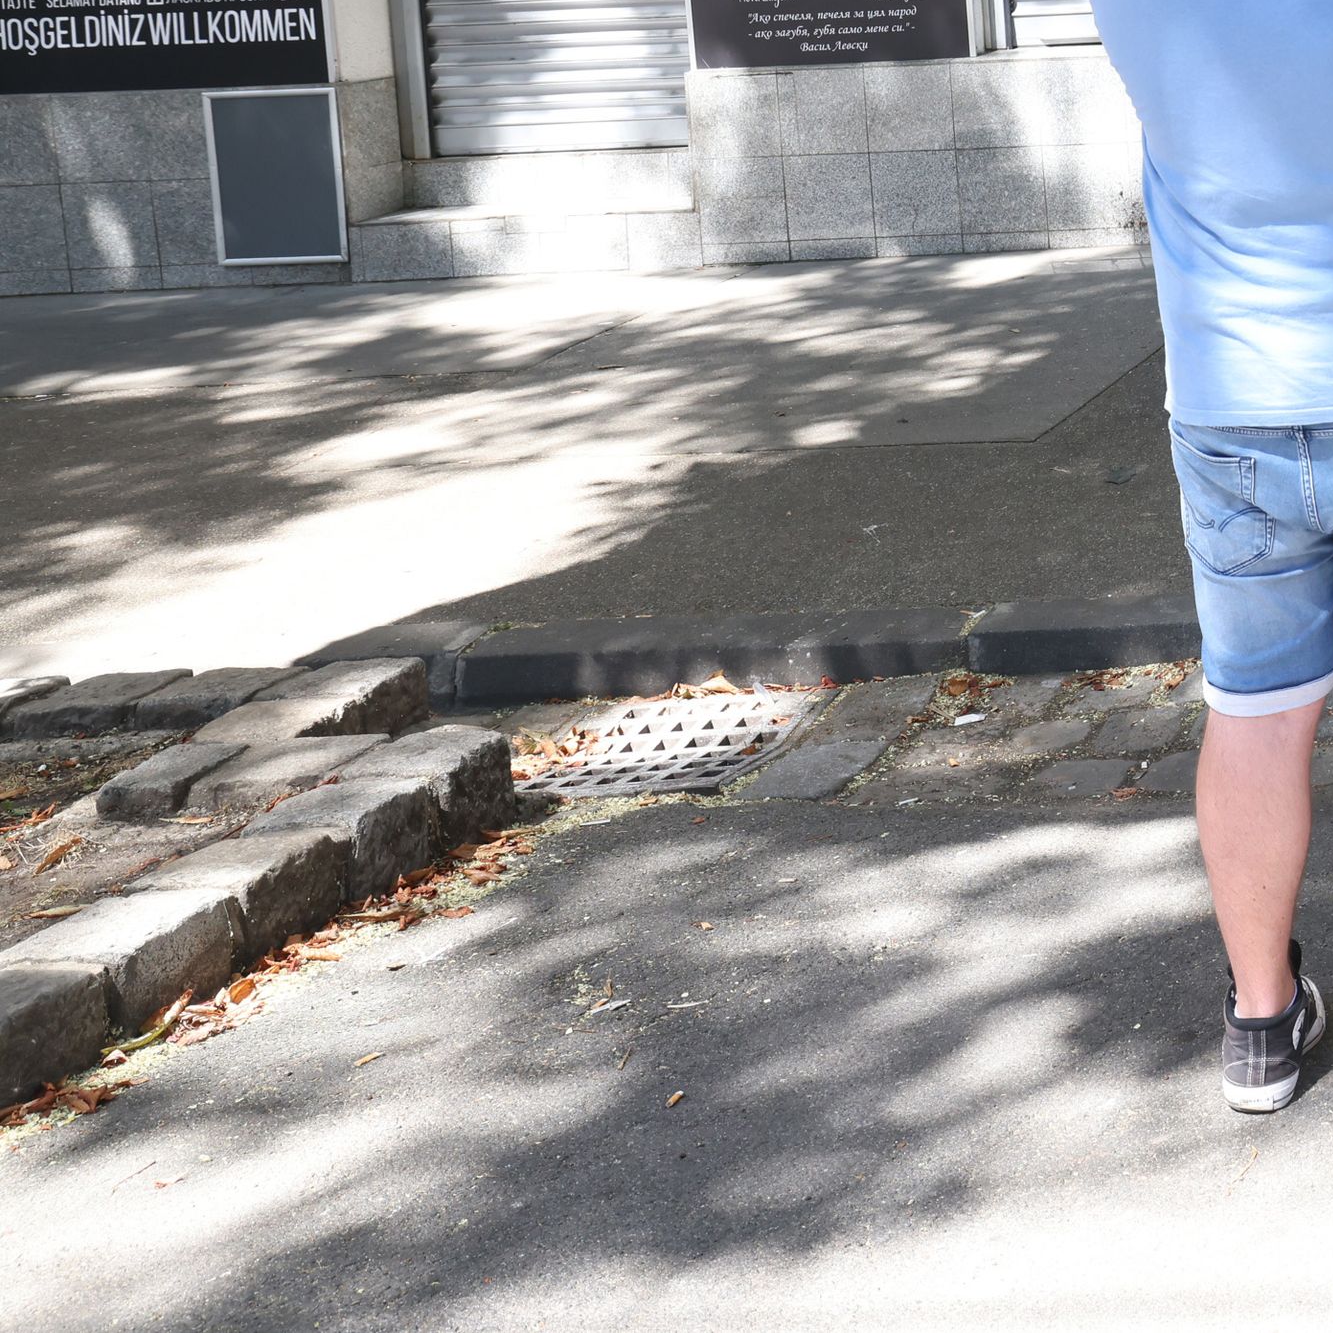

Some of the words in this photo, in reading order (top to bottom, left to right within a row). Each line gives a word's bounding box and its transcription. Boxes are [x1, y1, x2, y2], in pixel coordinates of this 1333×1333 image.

[773, 13, 814, 22] спечеля,
[817, 11, 850, 20] печеля
[867, 10, 885, 20] цял
[888, 5, 917, 20] народ
[147, 7, 317, 45] WILLKOMMEN
[754, 30, 773, 40] ако
[813, 24, 836, 37] губя
[838, 26, 863, 35] само
[864, 25, 889, 33] мене
[799, 42, 831, 52] Васил
[832, 40, 869, 52] Левски
